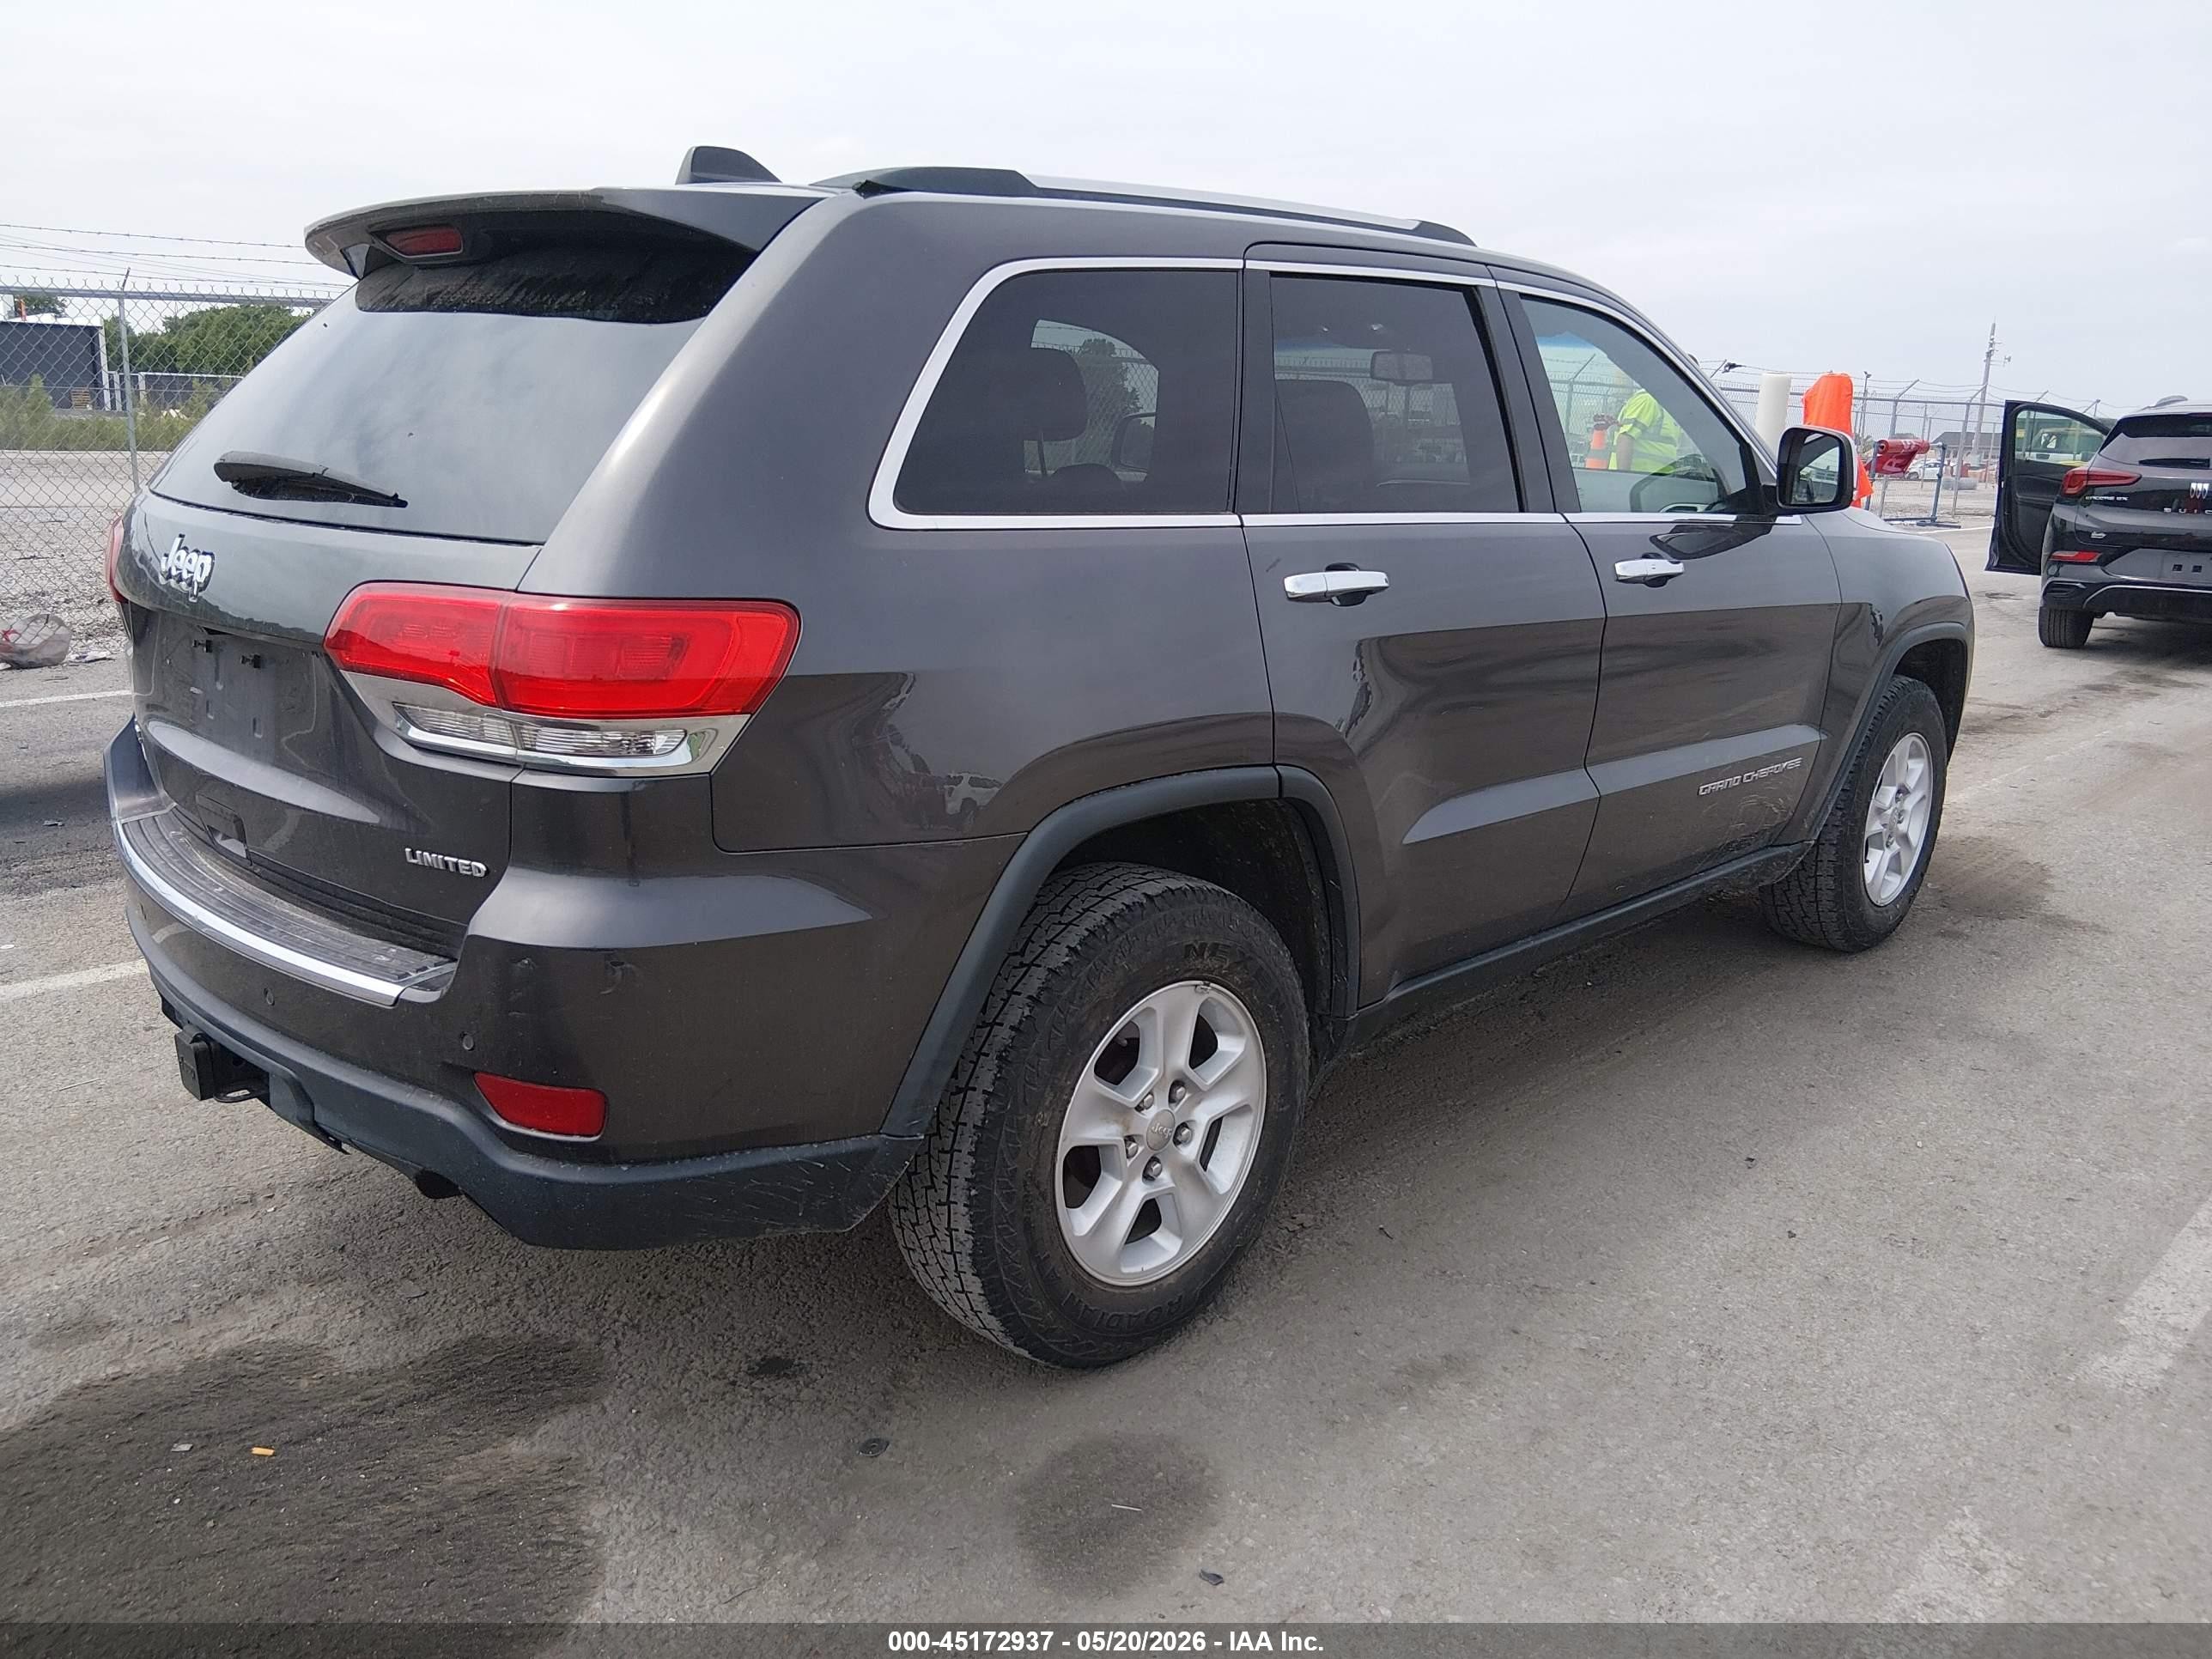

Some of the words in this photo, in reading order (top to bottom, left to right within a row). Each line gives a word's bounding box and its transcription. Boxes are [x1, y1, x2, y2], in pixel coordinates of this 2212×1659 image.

[158, 533, 215, 603] Jeep
[1698, 775, 1741, 795] GRAND
[1742, 757, 1802, 783] CHEROKEE
[404, 848, 488, 878] LIMITED
